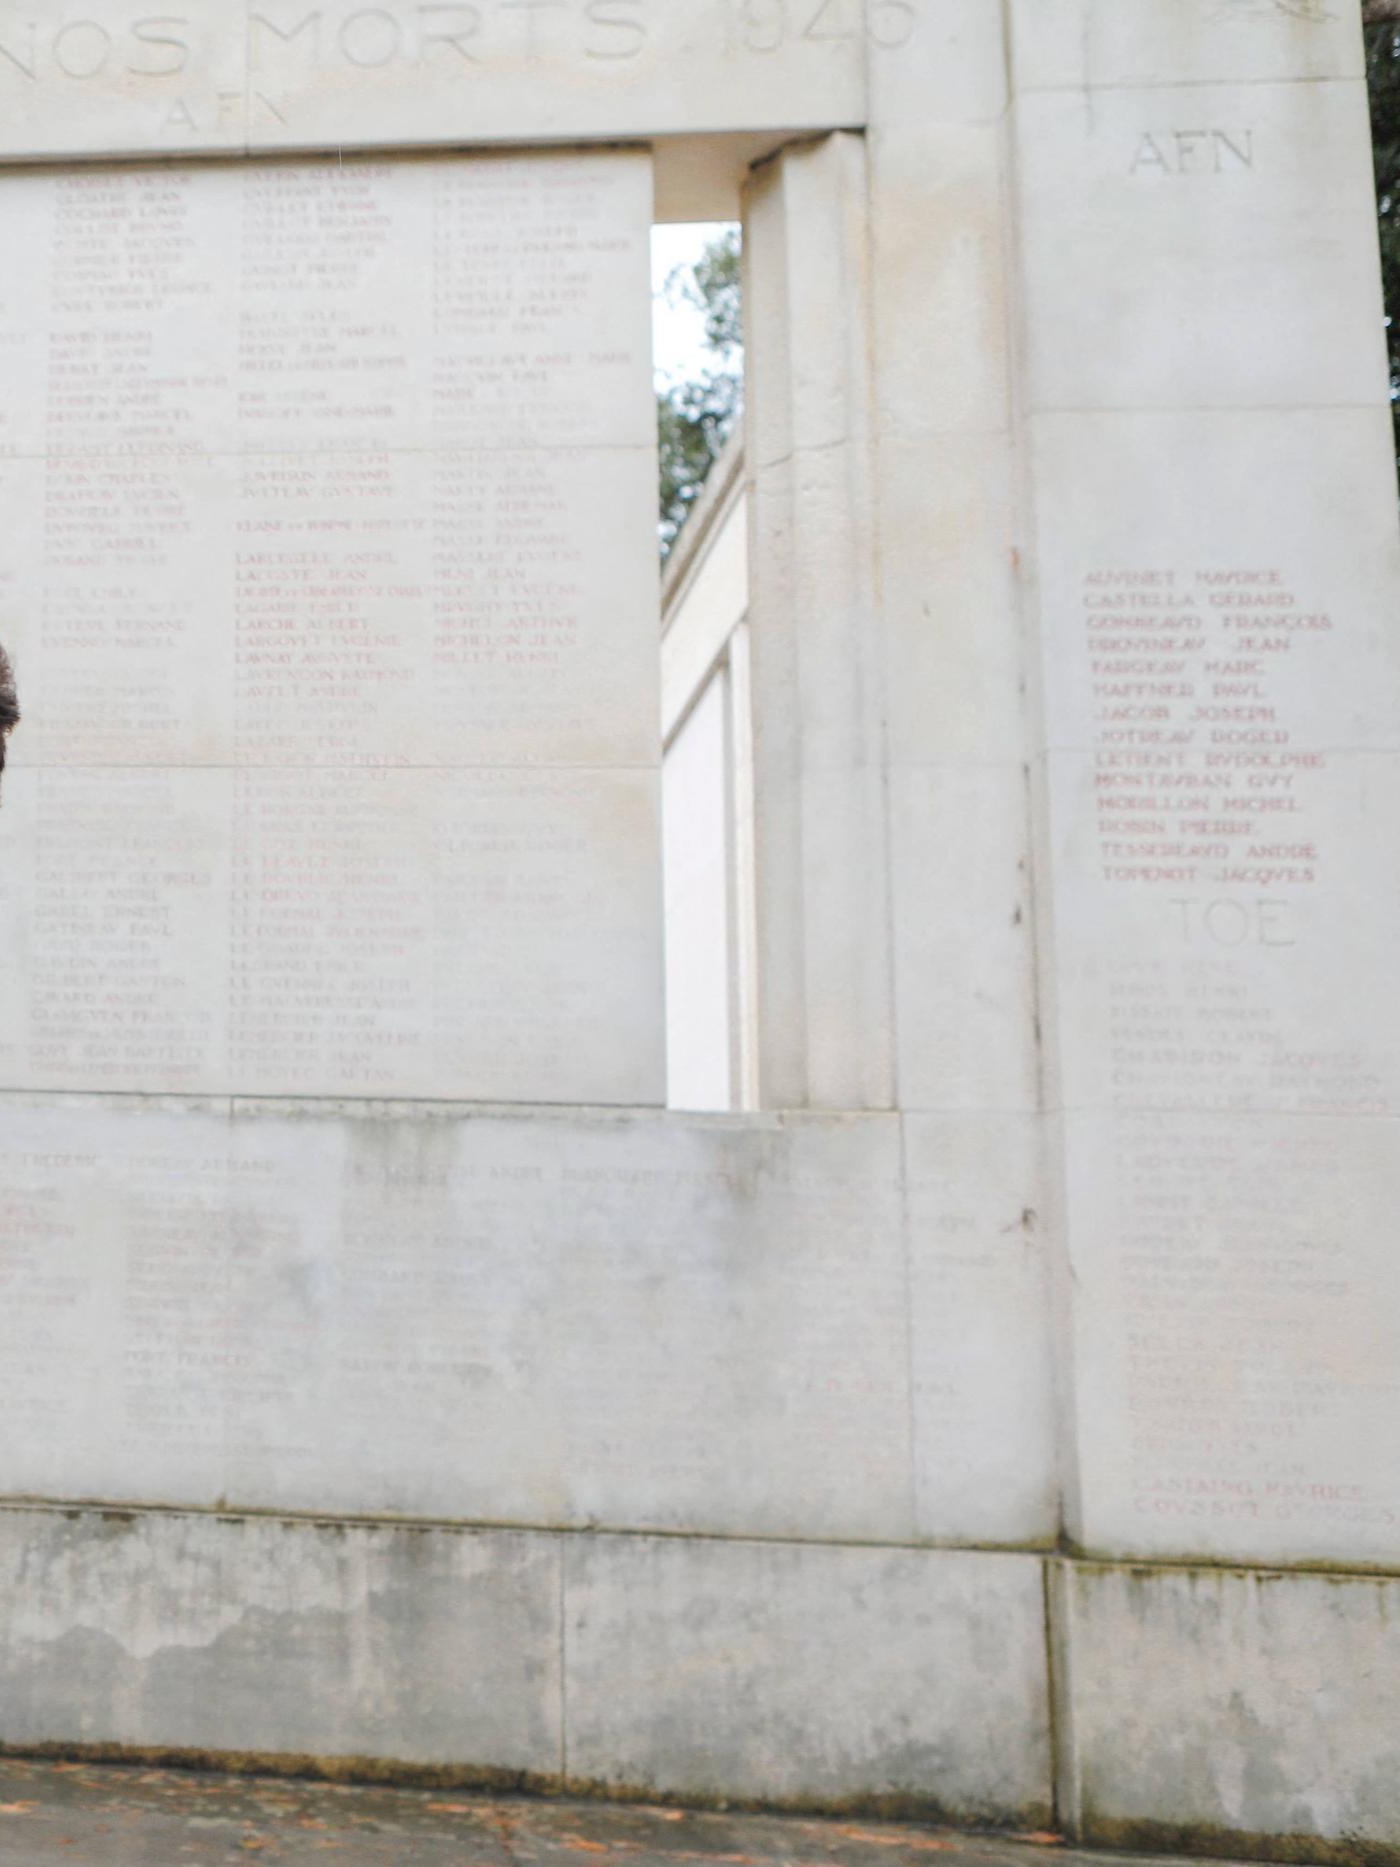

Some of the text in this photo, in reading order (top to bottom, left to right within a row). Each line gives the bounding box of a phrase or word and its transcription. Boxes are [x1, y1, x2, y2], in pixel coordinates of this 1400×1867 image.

[247, 2, 648, 70] MORTS
[1128, 128, 1253, 175] AFN
[1169, 898, 1295, 947] TOE
